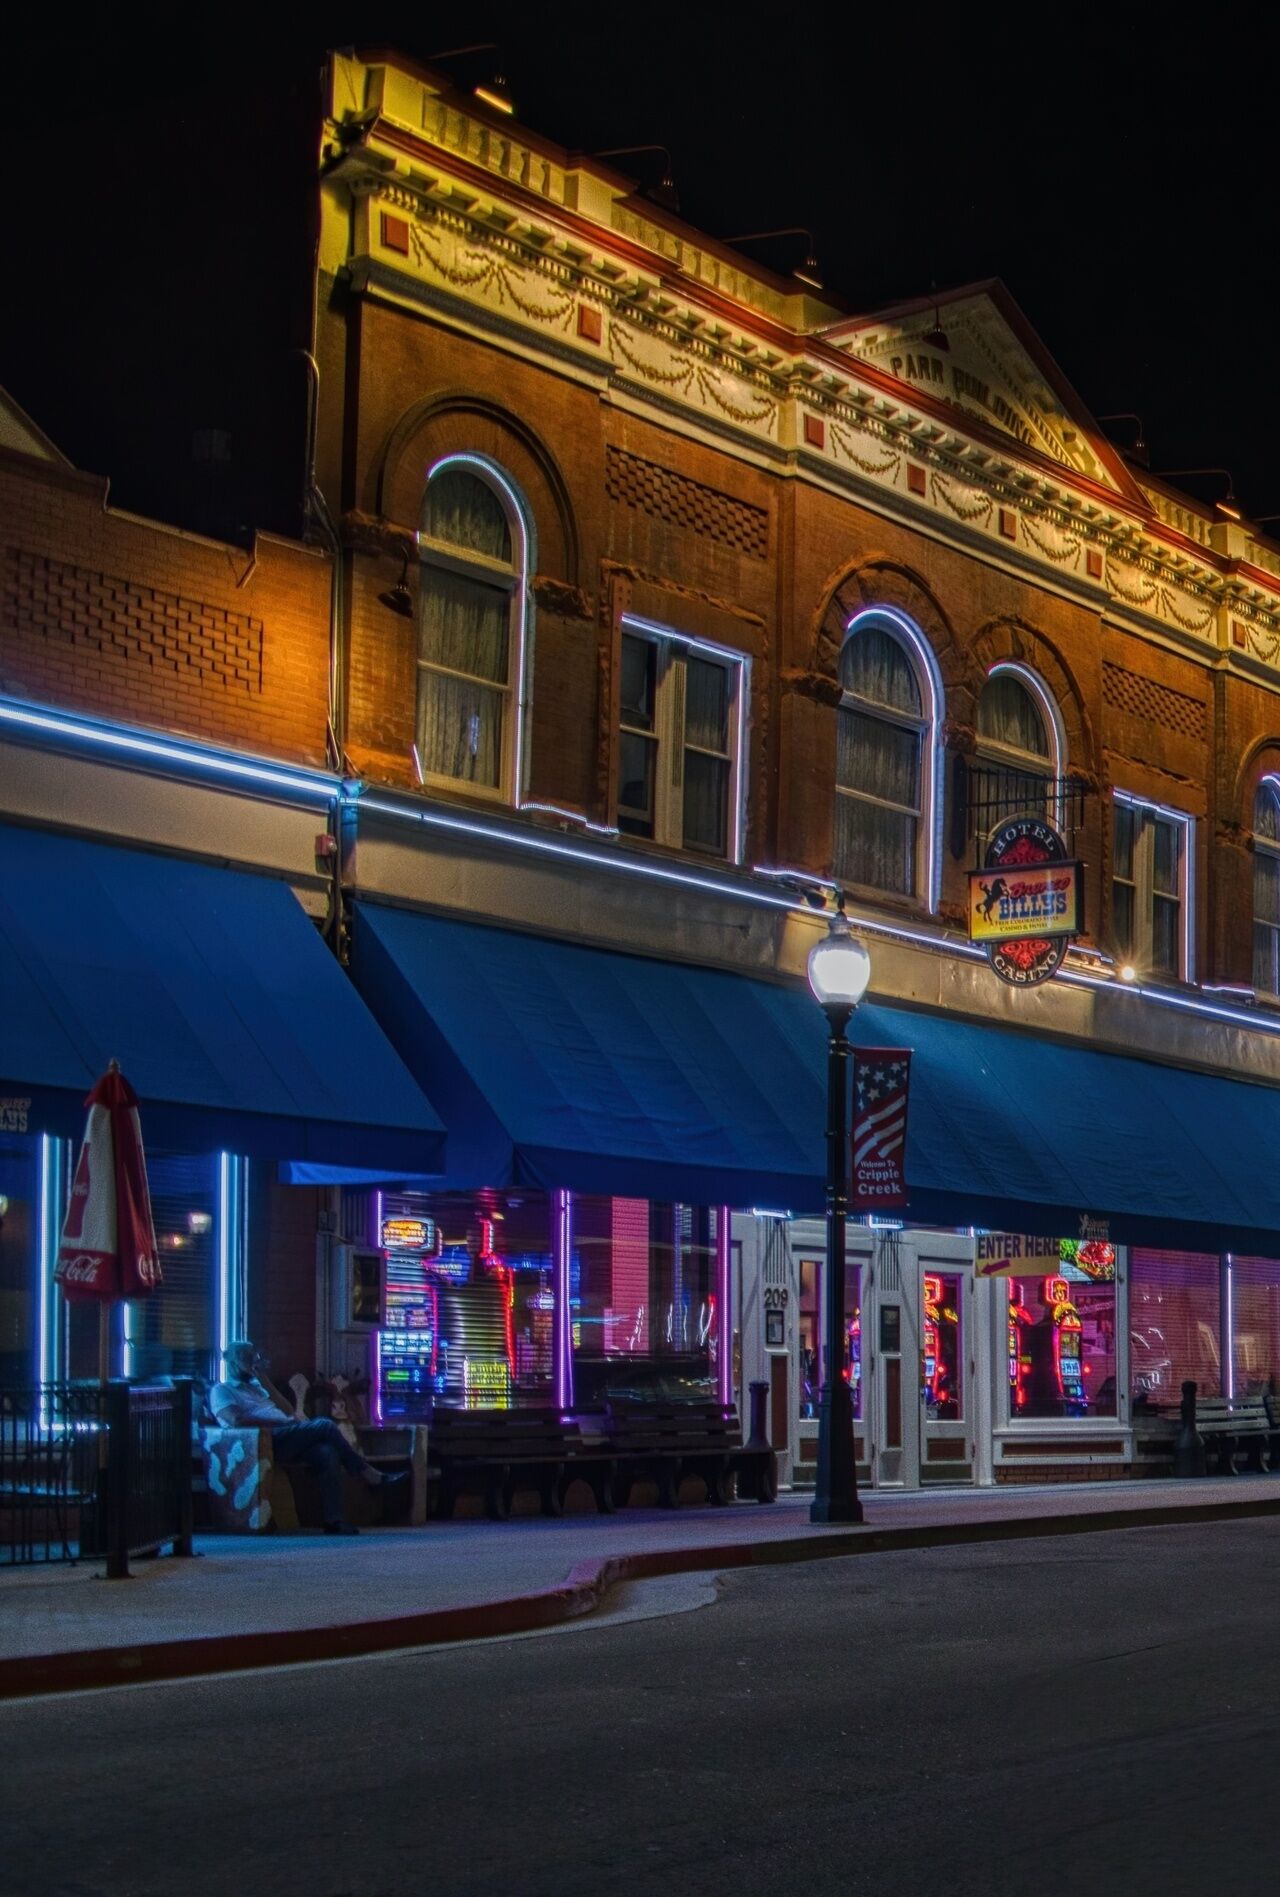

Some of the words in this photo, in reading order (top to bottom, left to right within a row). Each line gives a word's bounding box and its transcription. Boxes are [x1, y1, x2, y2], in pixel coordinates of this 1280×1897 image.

[890, 354, 943, 384] PARR
[993, 823, 1055, 858] HOTEL
[993, 951, 1058, 983] CASINO
[858, 1169, 900, 1181] Cripple
[860, 1160, 887, 1168] Welcome
[887, 1160, 896, 1168] To
[858, 1182, 902, 1195] Creek
[978, 1235, 1021, 1259] ENTER
[1025, 1236, 1060, 1257] HERE
[764, 1288, 788, 1309] 209
